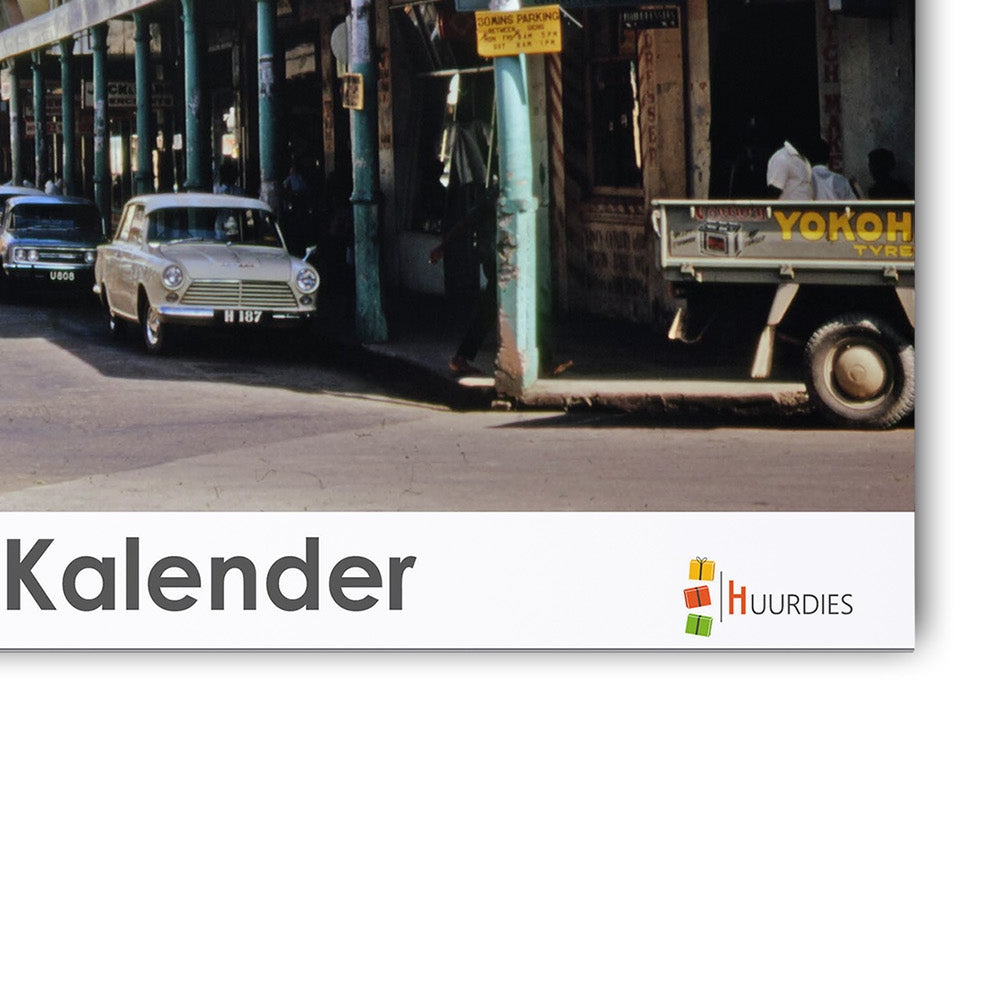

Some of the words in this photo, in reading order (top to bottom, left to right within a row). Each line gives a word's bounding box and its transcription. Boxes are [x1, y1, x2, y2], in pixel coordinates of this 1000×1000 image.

[516, 11, 559, 24] PARKING
[773, 211, 913, 242] YOKOH
[853, 244, 913, 257] TYRE
[50, 271, 75, 281] U808
[224, 310, 234, 323] H
[239, 310, 262, 323] 187
[6, 537, 417, 612] Kalender
[728, 580, 853, 615] HUURDIES
